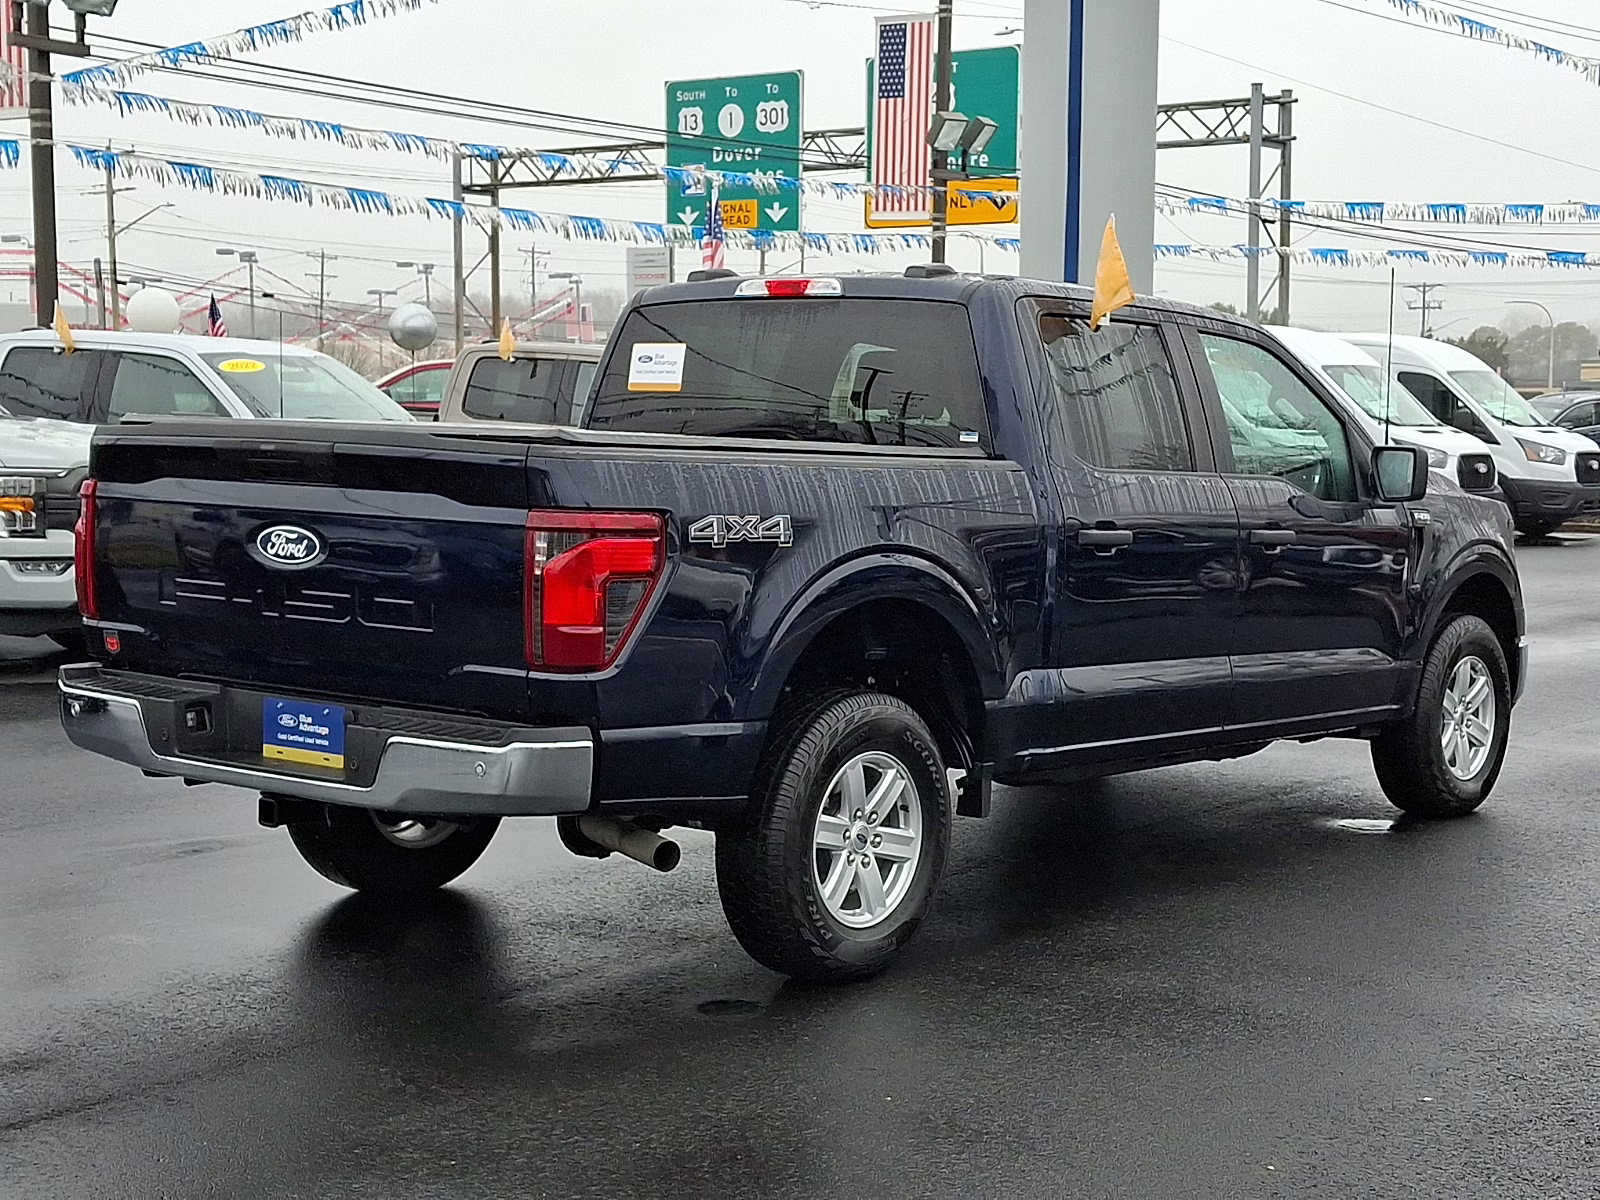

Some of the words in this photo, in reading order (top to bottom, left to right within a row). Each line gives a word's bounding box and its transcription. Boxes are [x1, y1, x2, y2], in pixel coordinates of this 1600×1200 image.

[684, 113, 699, 131] 13
[759, 107, 785, 126] 301
[712, 146, 762, 162] Dover
[722, 203, 751, 214] GNAL
[721, 215, 751, 226] HEAD
[265, 529, 309, 559] Ford
[299, 714, 313, 723] Blue
[299, 723, 330, 736] Advantage
